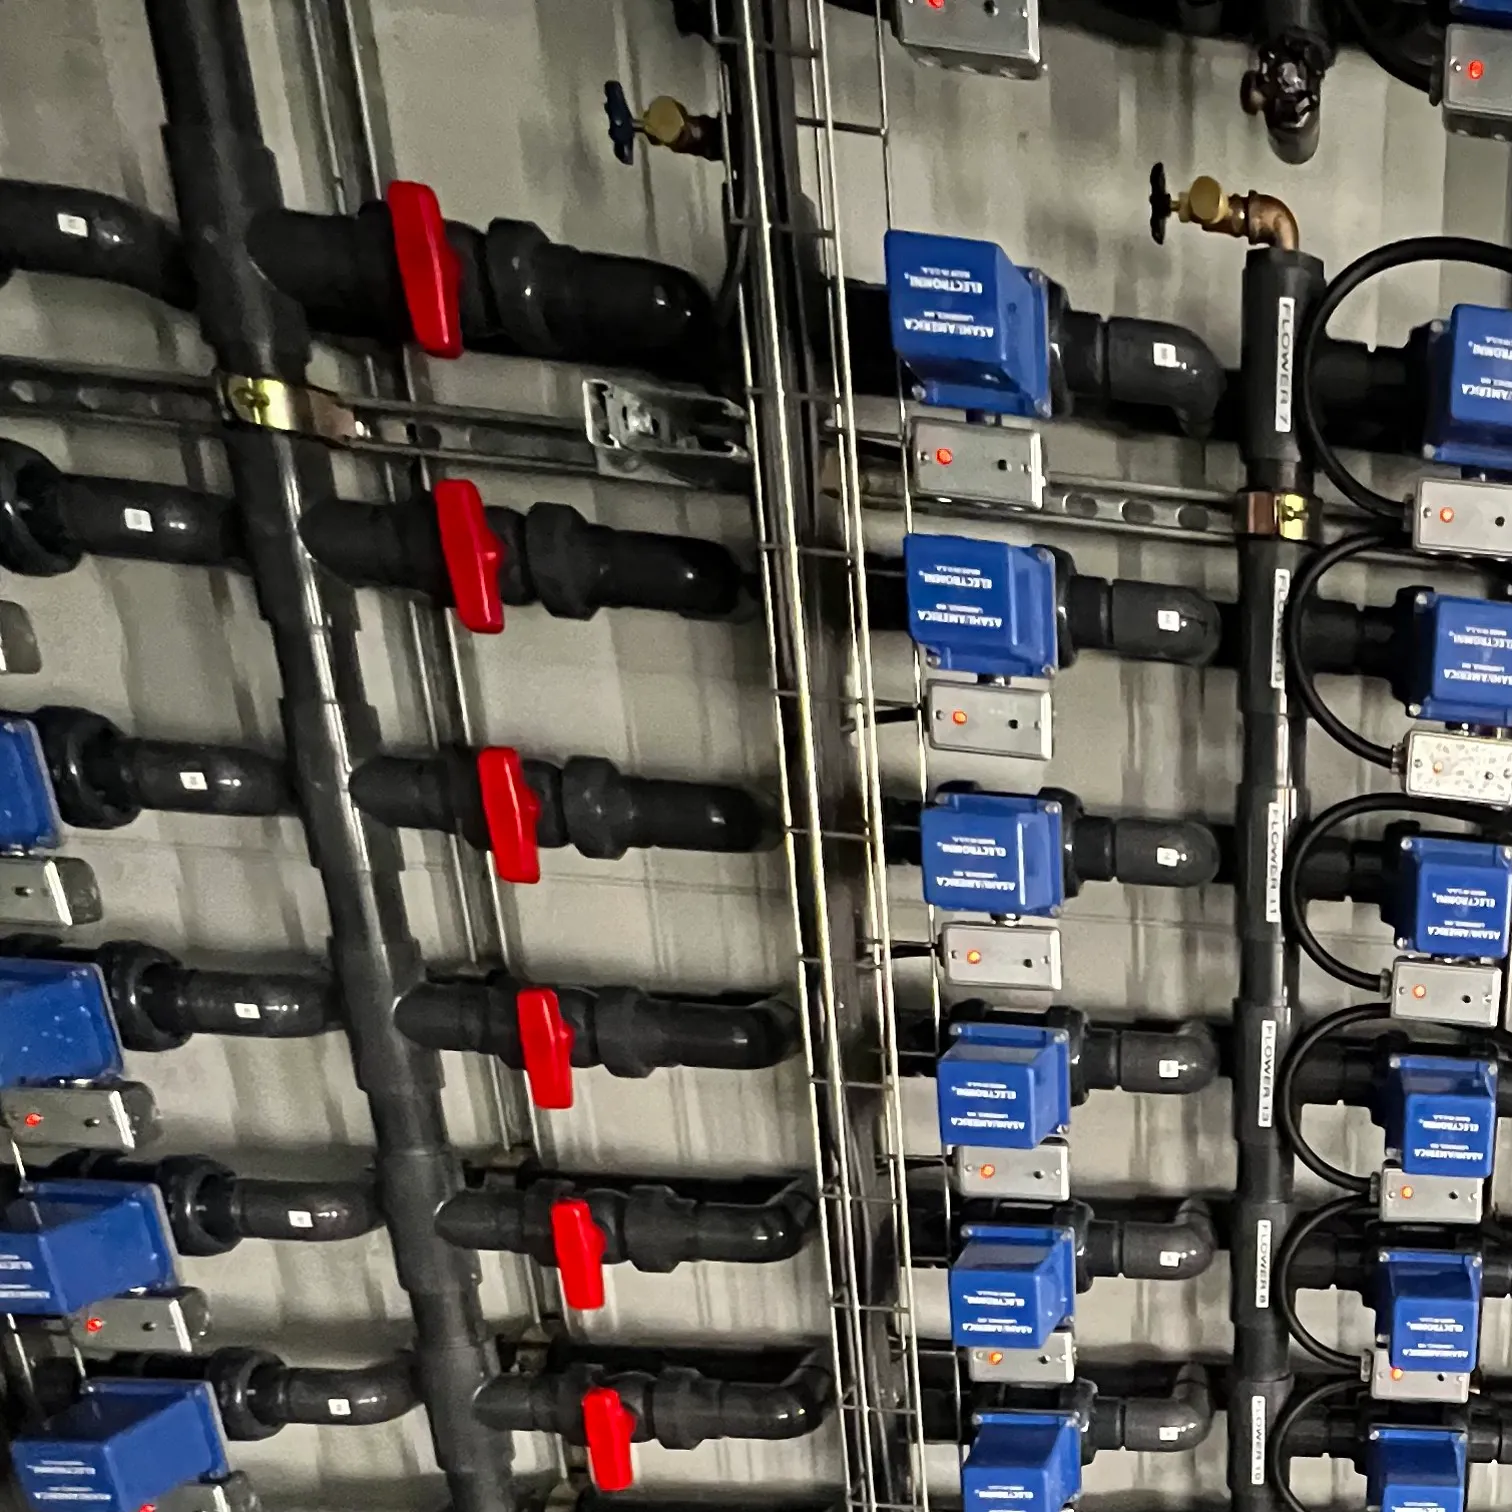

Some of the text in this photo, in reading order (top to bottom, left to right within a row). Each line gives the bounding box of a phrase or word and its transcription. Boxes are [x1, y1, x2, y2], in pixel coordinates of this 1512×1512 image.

[1279, 303, 1291, 425] FLOWER 7
[1269, 809, 1279, 914] FLOWER 11
[1261, 1026, 1272, 1122] FLOWER 13
[1259, 1224, 1268, 1290] FLOWER
[1254, 1400, 1262, 1461] FLOWER
